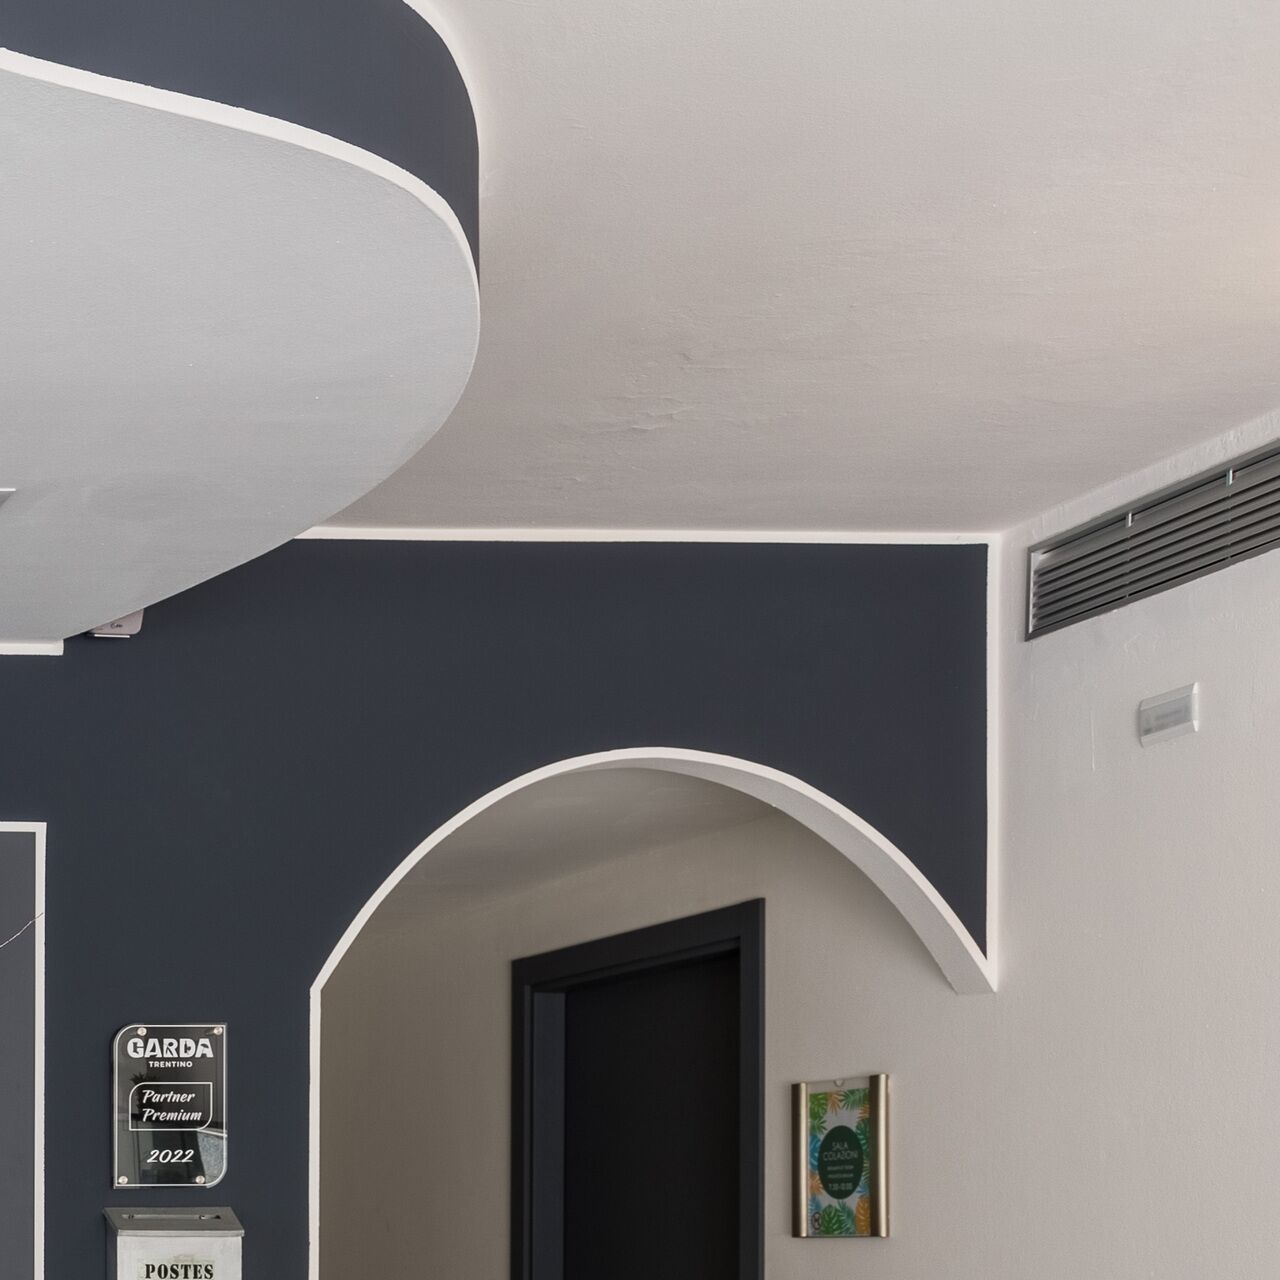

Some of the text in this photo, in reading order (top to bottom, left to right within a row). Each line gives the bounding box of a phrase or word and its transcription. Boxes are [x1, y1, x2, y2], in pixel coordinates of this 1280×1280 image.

[126, 1037, 215, 1059] GARDA
[148, 1060, 193, 1069] TRENTINO
[142, 1088, 196, 1104] Partner
[142, 1107, 202, 1123] Premium
[146, 1149, 195, 1164] 2022
[144, 1263, 214, 1280] POSTES
